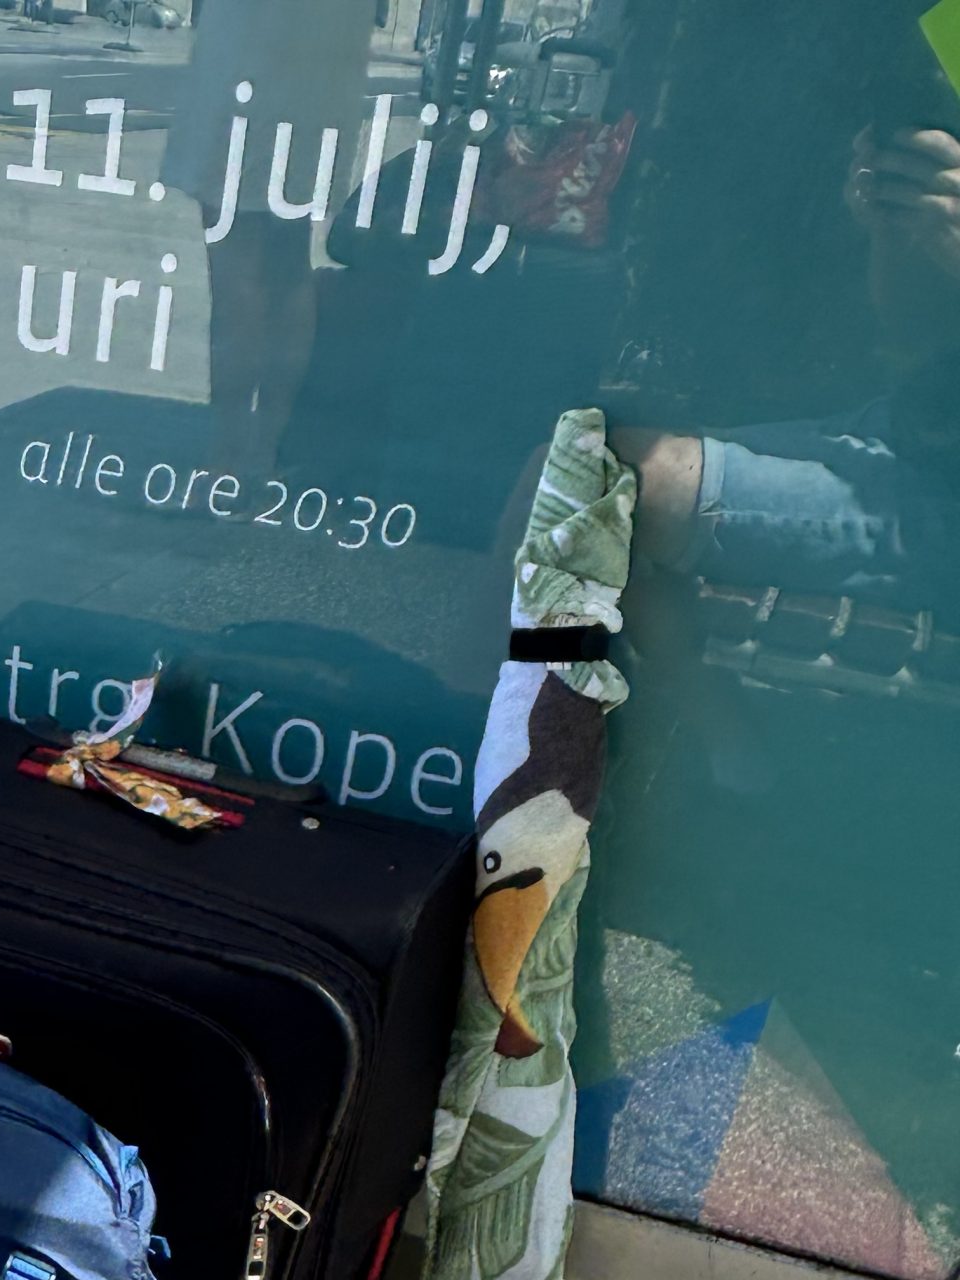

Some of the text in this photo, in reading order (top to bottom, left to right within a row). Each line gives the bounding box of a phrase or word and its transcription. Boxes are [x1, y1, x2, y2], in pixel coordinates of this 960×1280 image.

[5, 88, 167, 202] 11.
[203, 80, 511, 276] julij,
[17, 253, 178, 372] uri
[19, 430, 126, 497] alle
[143, 462, 242, 518] ore
[252, 480, 418, 550] 20:30
